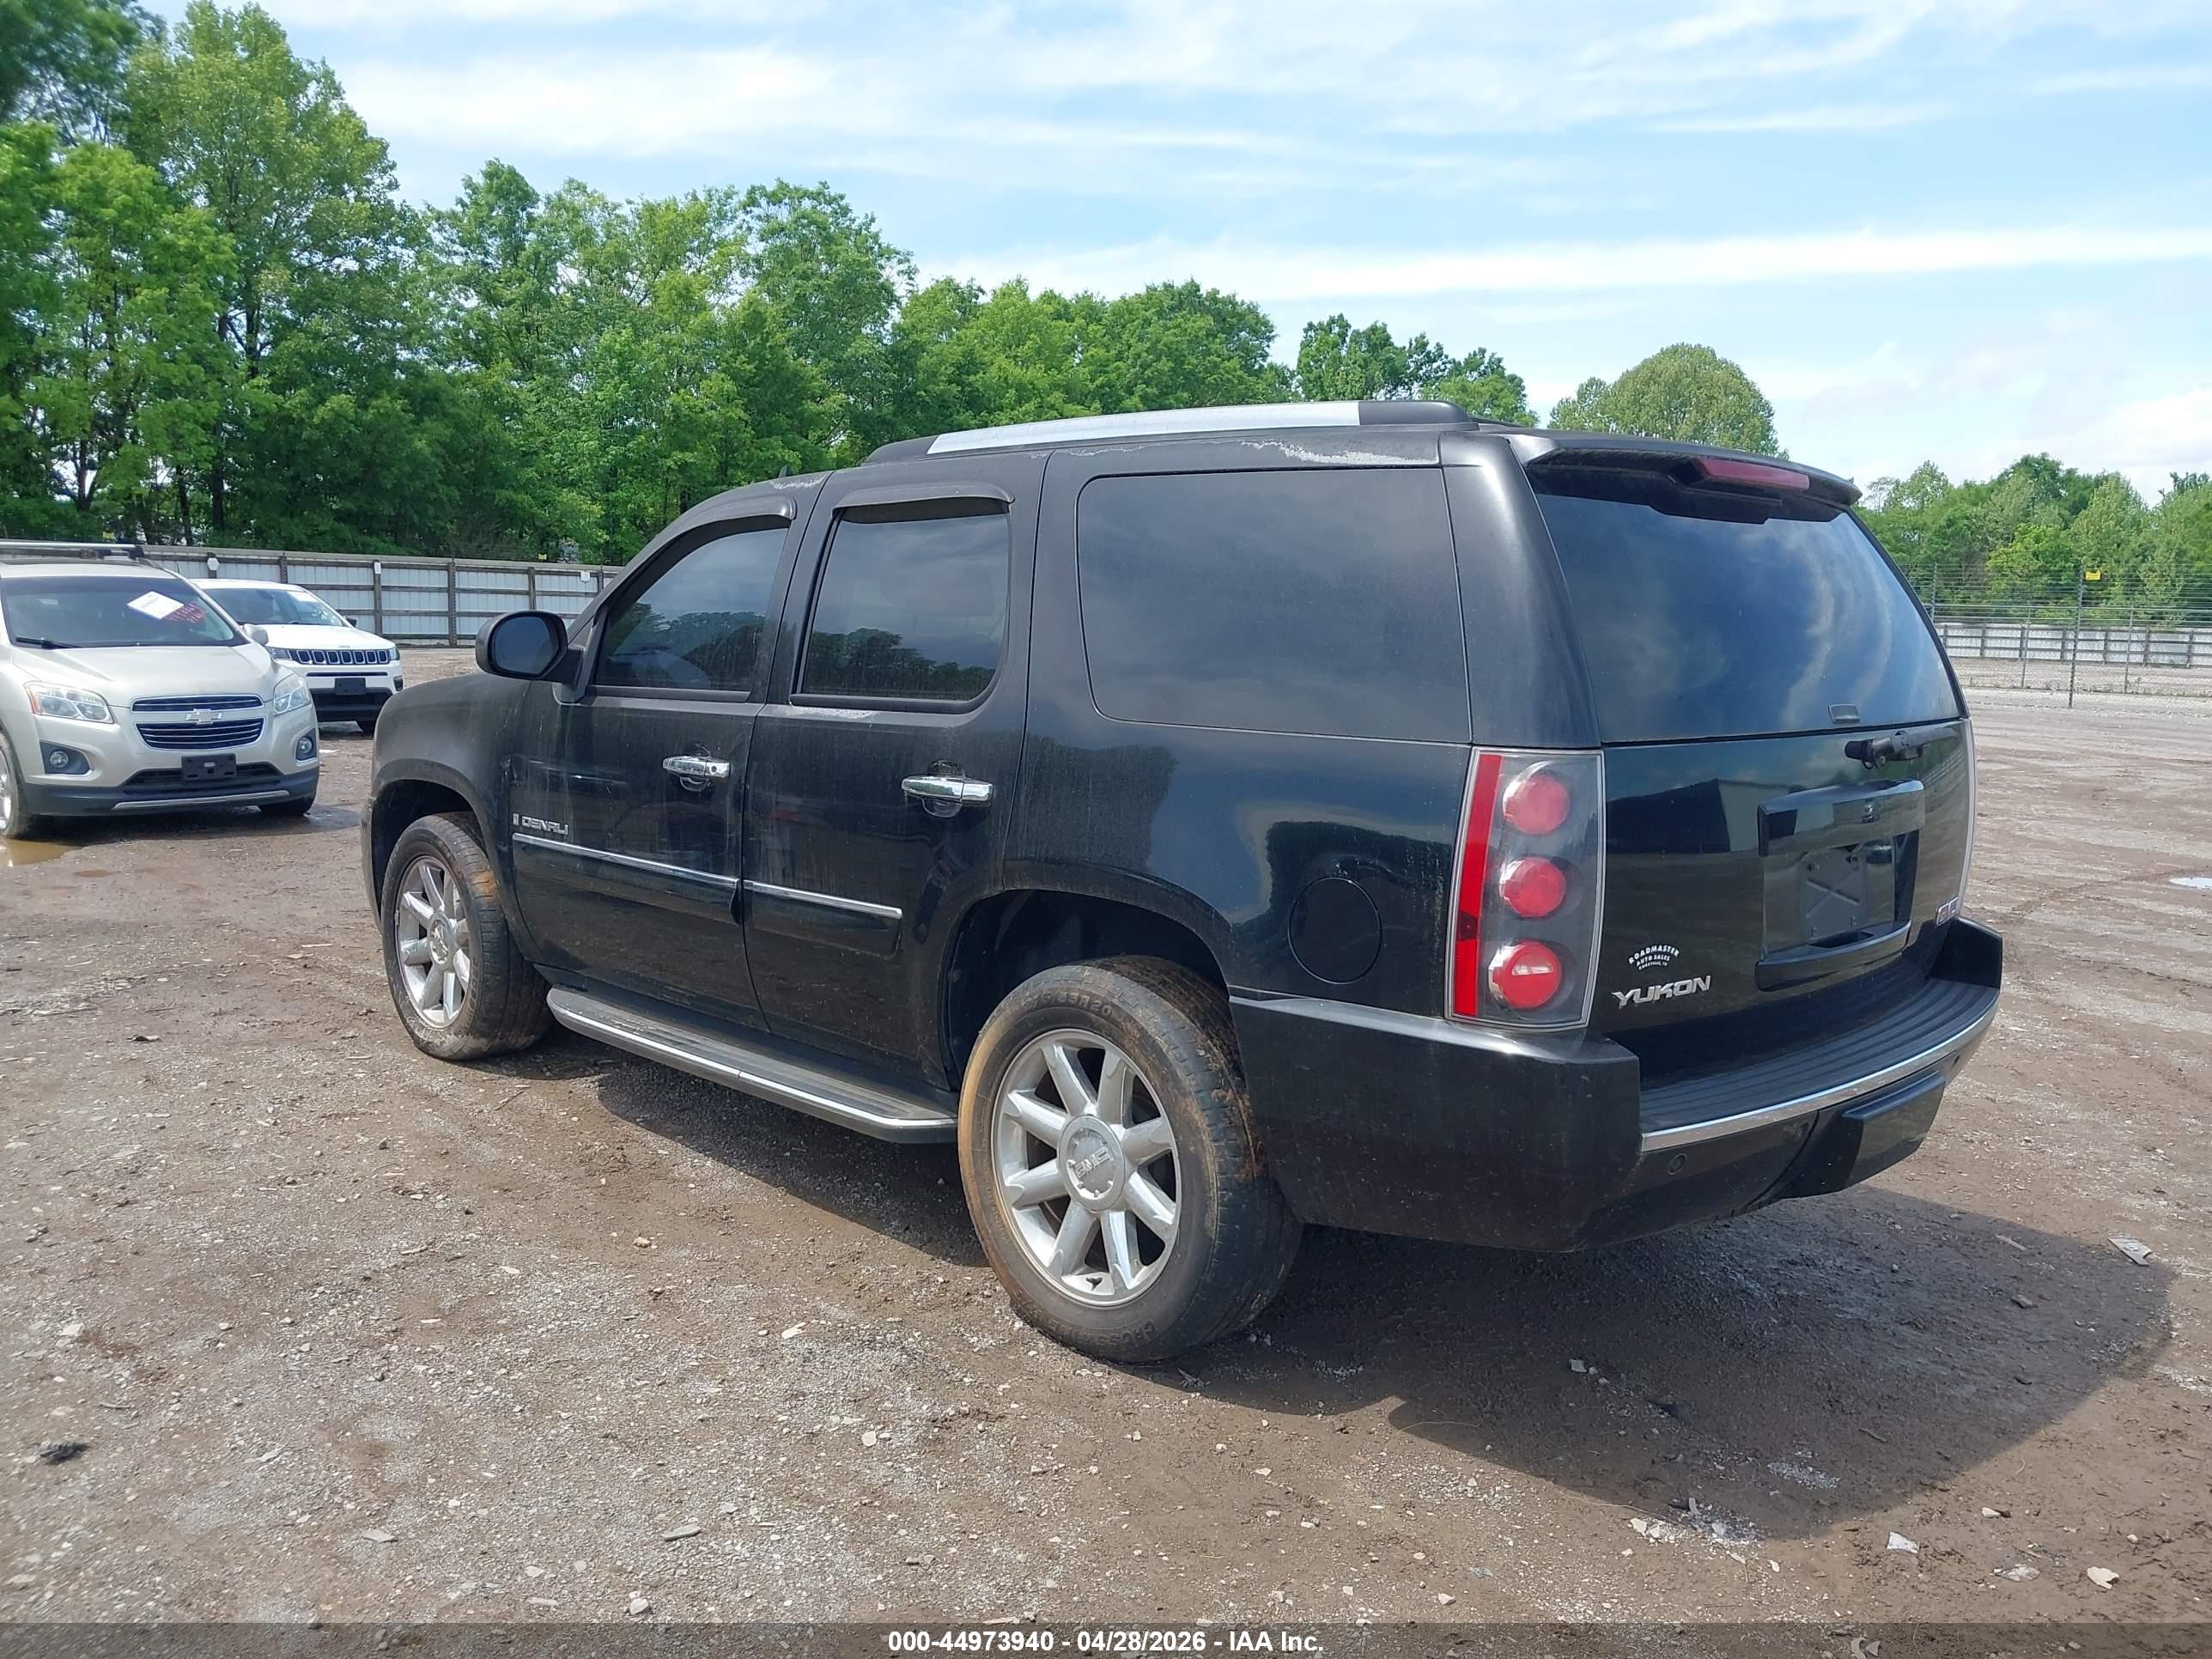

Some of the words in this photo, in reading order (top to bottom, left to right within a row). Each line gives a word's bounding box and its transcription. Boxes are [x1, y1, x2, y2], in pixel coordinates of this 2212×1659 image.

[521, 815, 569, 836] DENALI
[1628, 944, 1680, 965] ROADMASTER
[1636, 955, 1653, 968] AUTO
[1611, 975, 1711, 1010] YUKON
[1074, 1146, 1115, 1179] GMC
